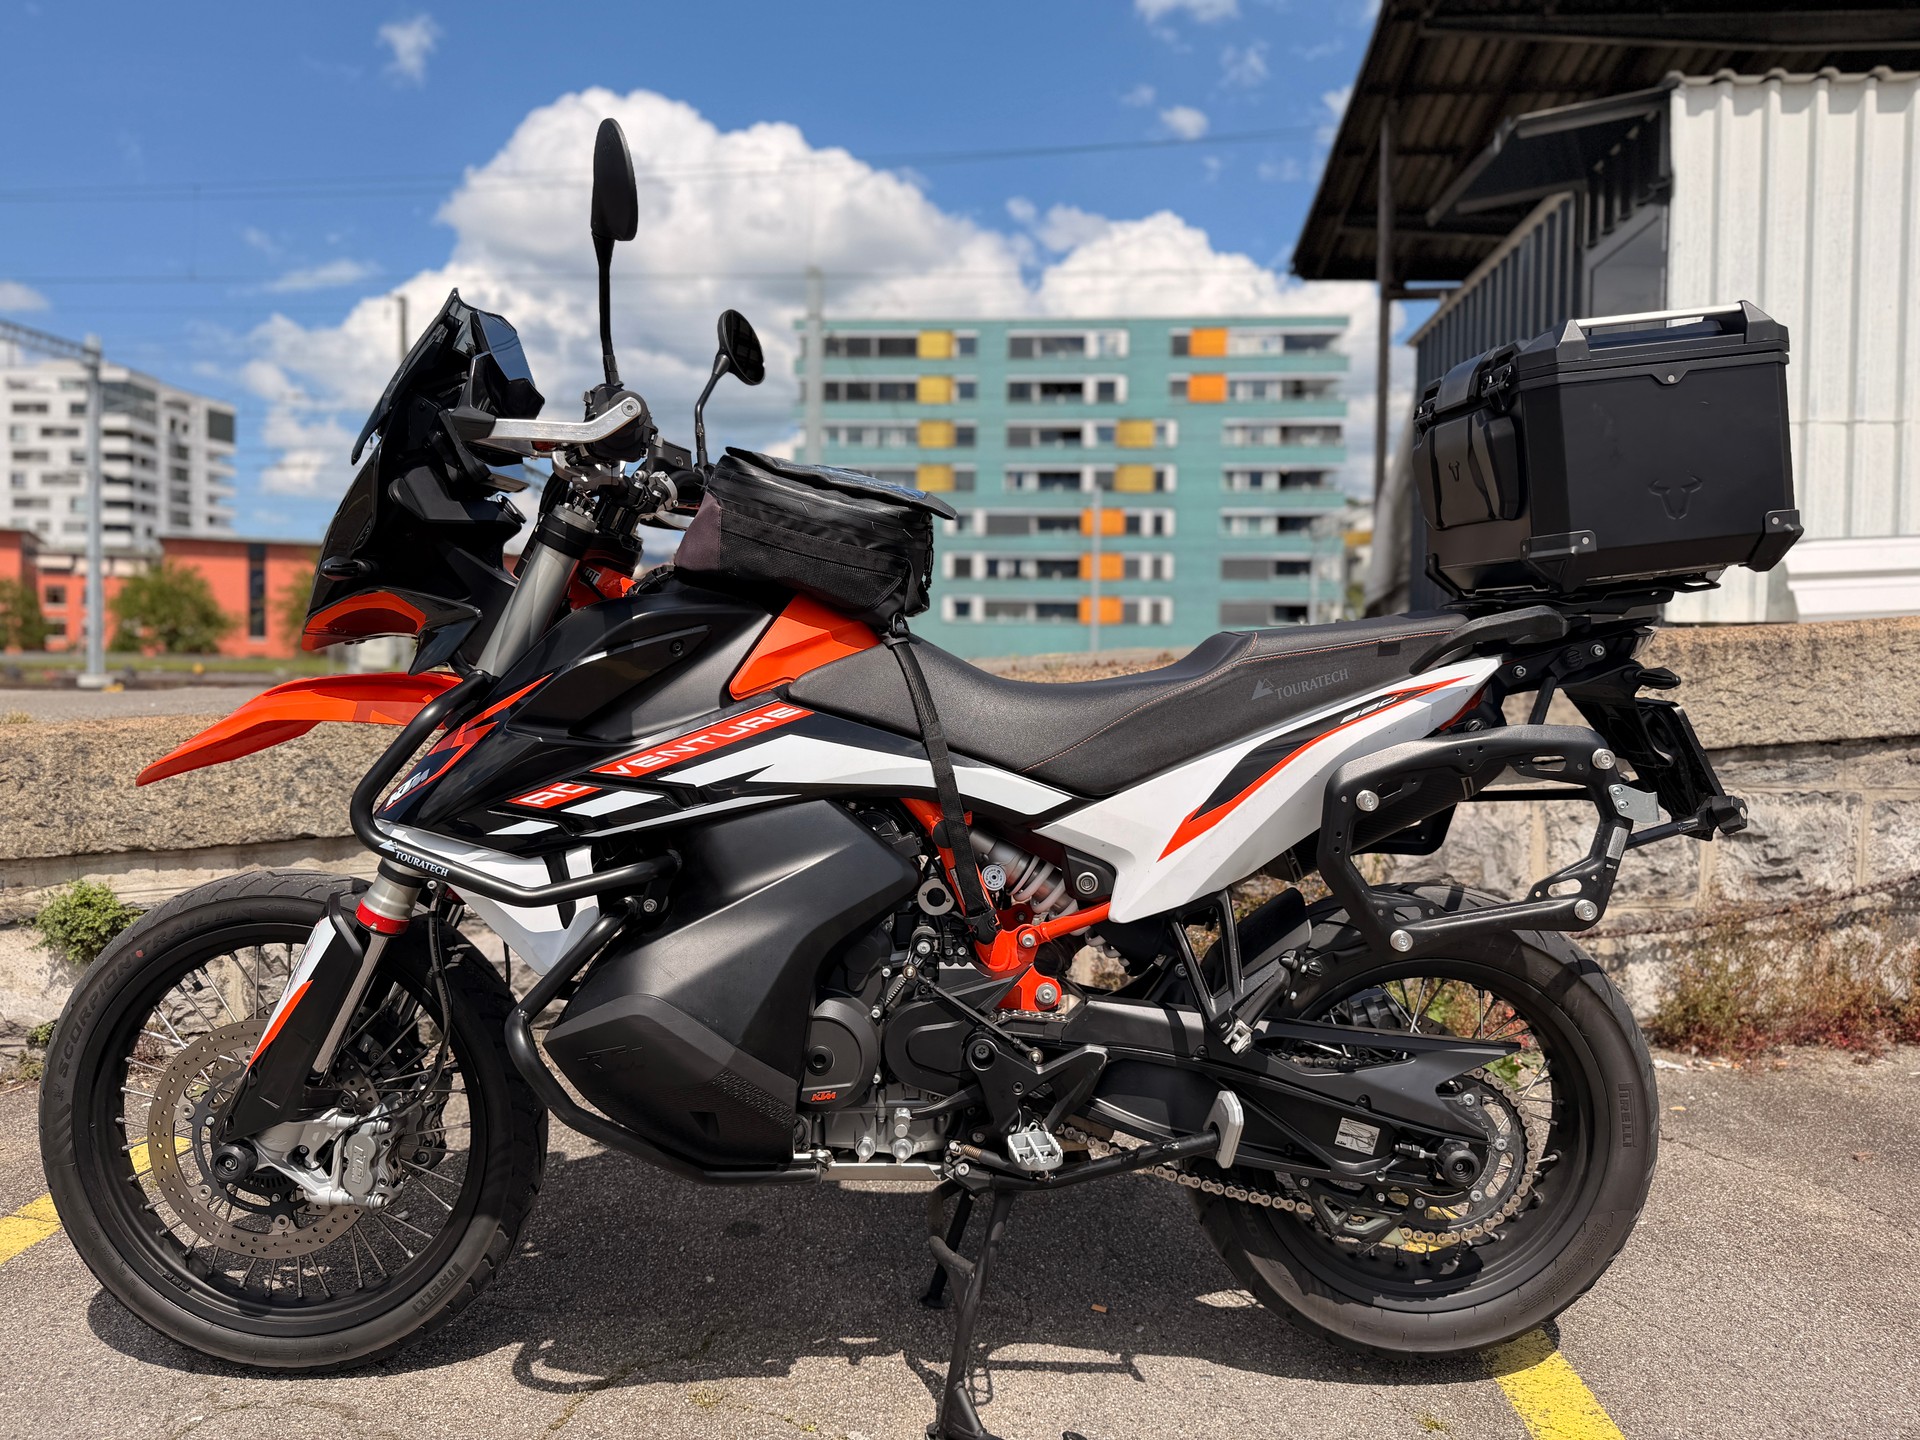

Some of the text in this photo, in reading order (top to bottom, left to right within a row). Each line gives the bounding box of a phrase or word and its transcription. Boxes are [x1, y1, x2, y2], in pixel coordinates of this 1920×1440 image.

[1274, 668, 1350, 700] TOURATECH
[386, 768, 431, 807] KTM
[395, 851, 449, 877] TOURATECH
[58, 955, 137, 1078] SCORPION
[811, 1090, 837, 1102] KTM
[1618, 1083, 1638, 1149] PIRELLI
[411, 1262, 466, 1316] PIRELLI
